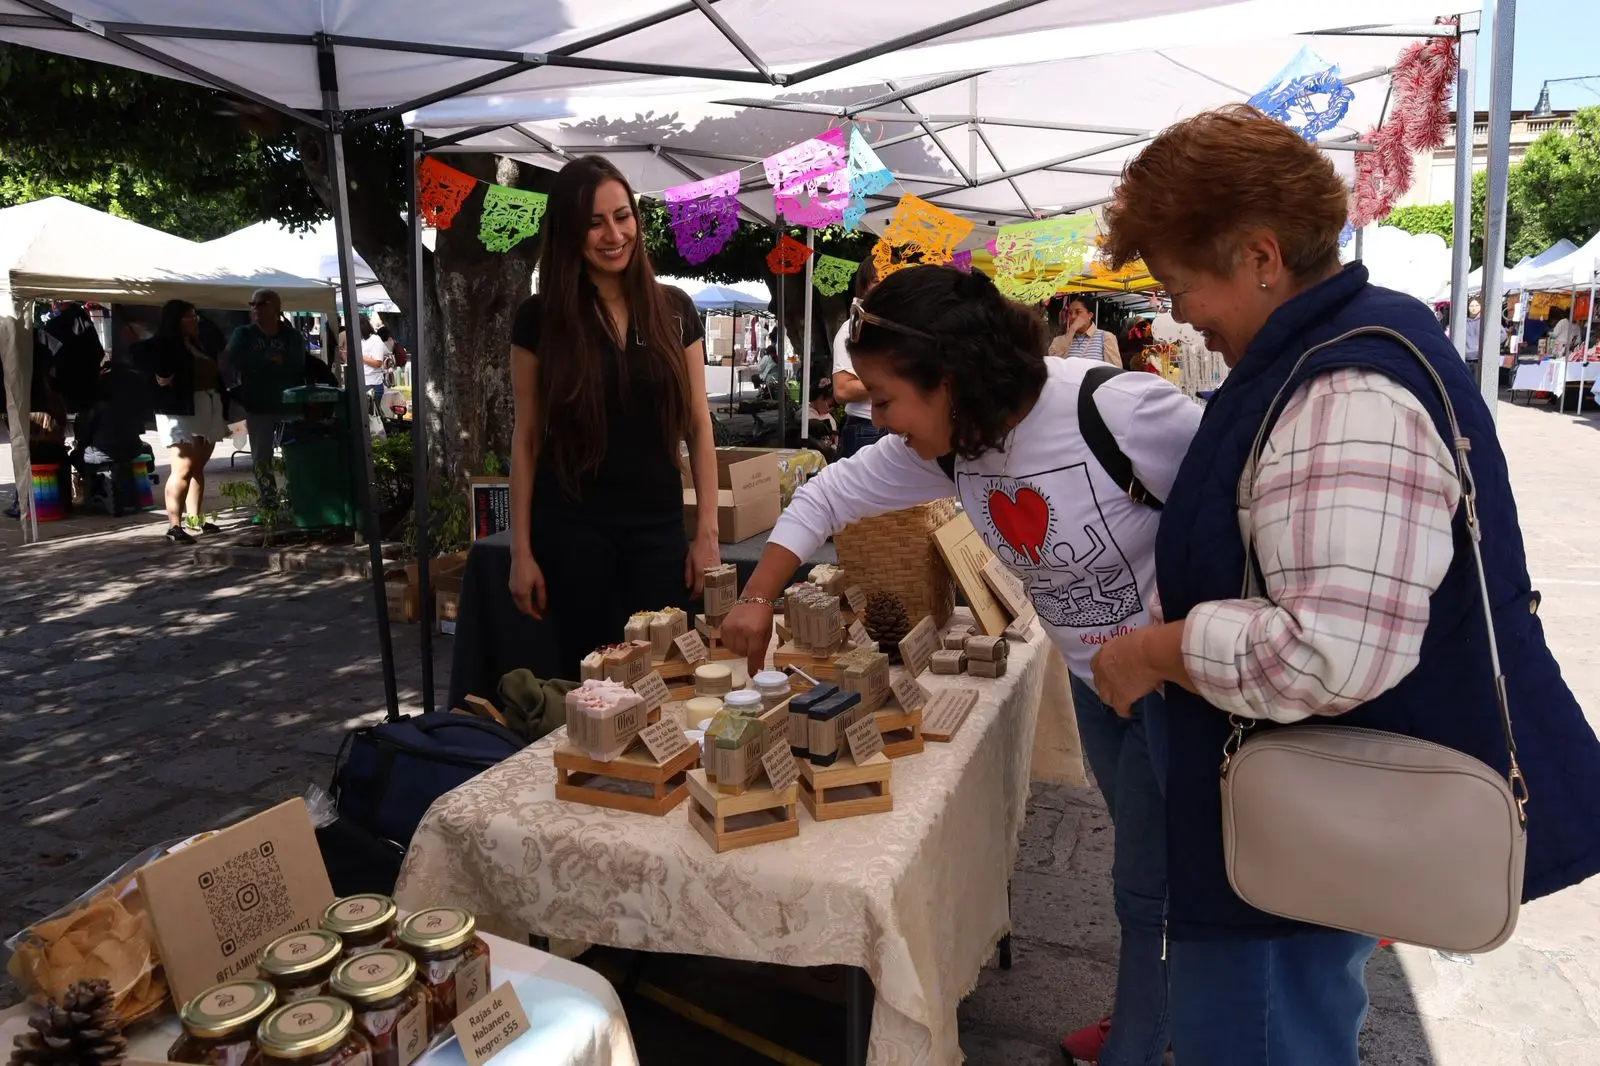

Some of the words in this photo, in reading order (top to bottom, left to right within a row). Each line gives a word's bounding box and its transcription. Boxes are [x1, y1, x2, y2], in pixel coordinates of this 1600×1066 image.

[469, 1008, 491, 1027] Rajas
[492, 999, 503, 1010] de
[472, 1011, 510, 1042] Habanero
[474, 1034, 502, 1058] Negro:
[503, 1020, 518, 1037] $55
